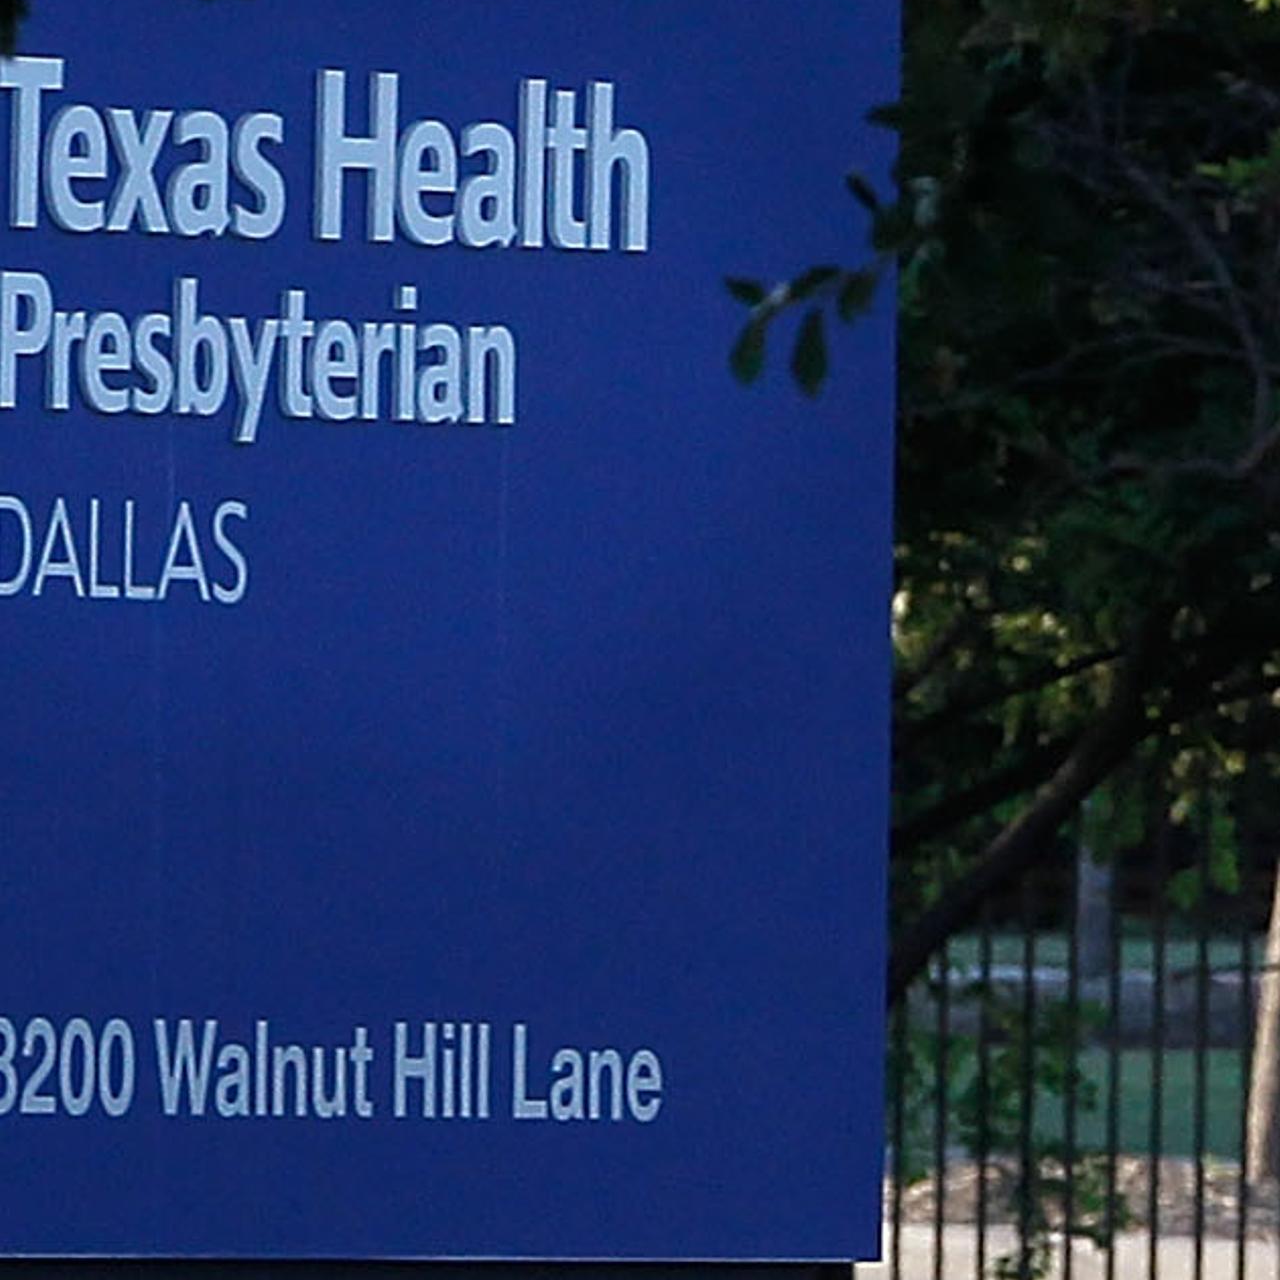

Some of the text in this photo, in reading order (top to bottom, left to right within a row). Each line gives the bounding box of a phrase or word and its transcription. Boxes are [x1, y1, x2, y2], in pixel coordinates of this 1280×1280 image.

[0, 57, 648, 251] Texas Health
[0, 271, 515, 442] Presbyterian
[0, 496, 246, 603] DALLAS
[155, 1019, 373, 1117] Walnut
[395, 1022, 489, 1118] Hill
[514, 1024, 661, 1121] Lane
